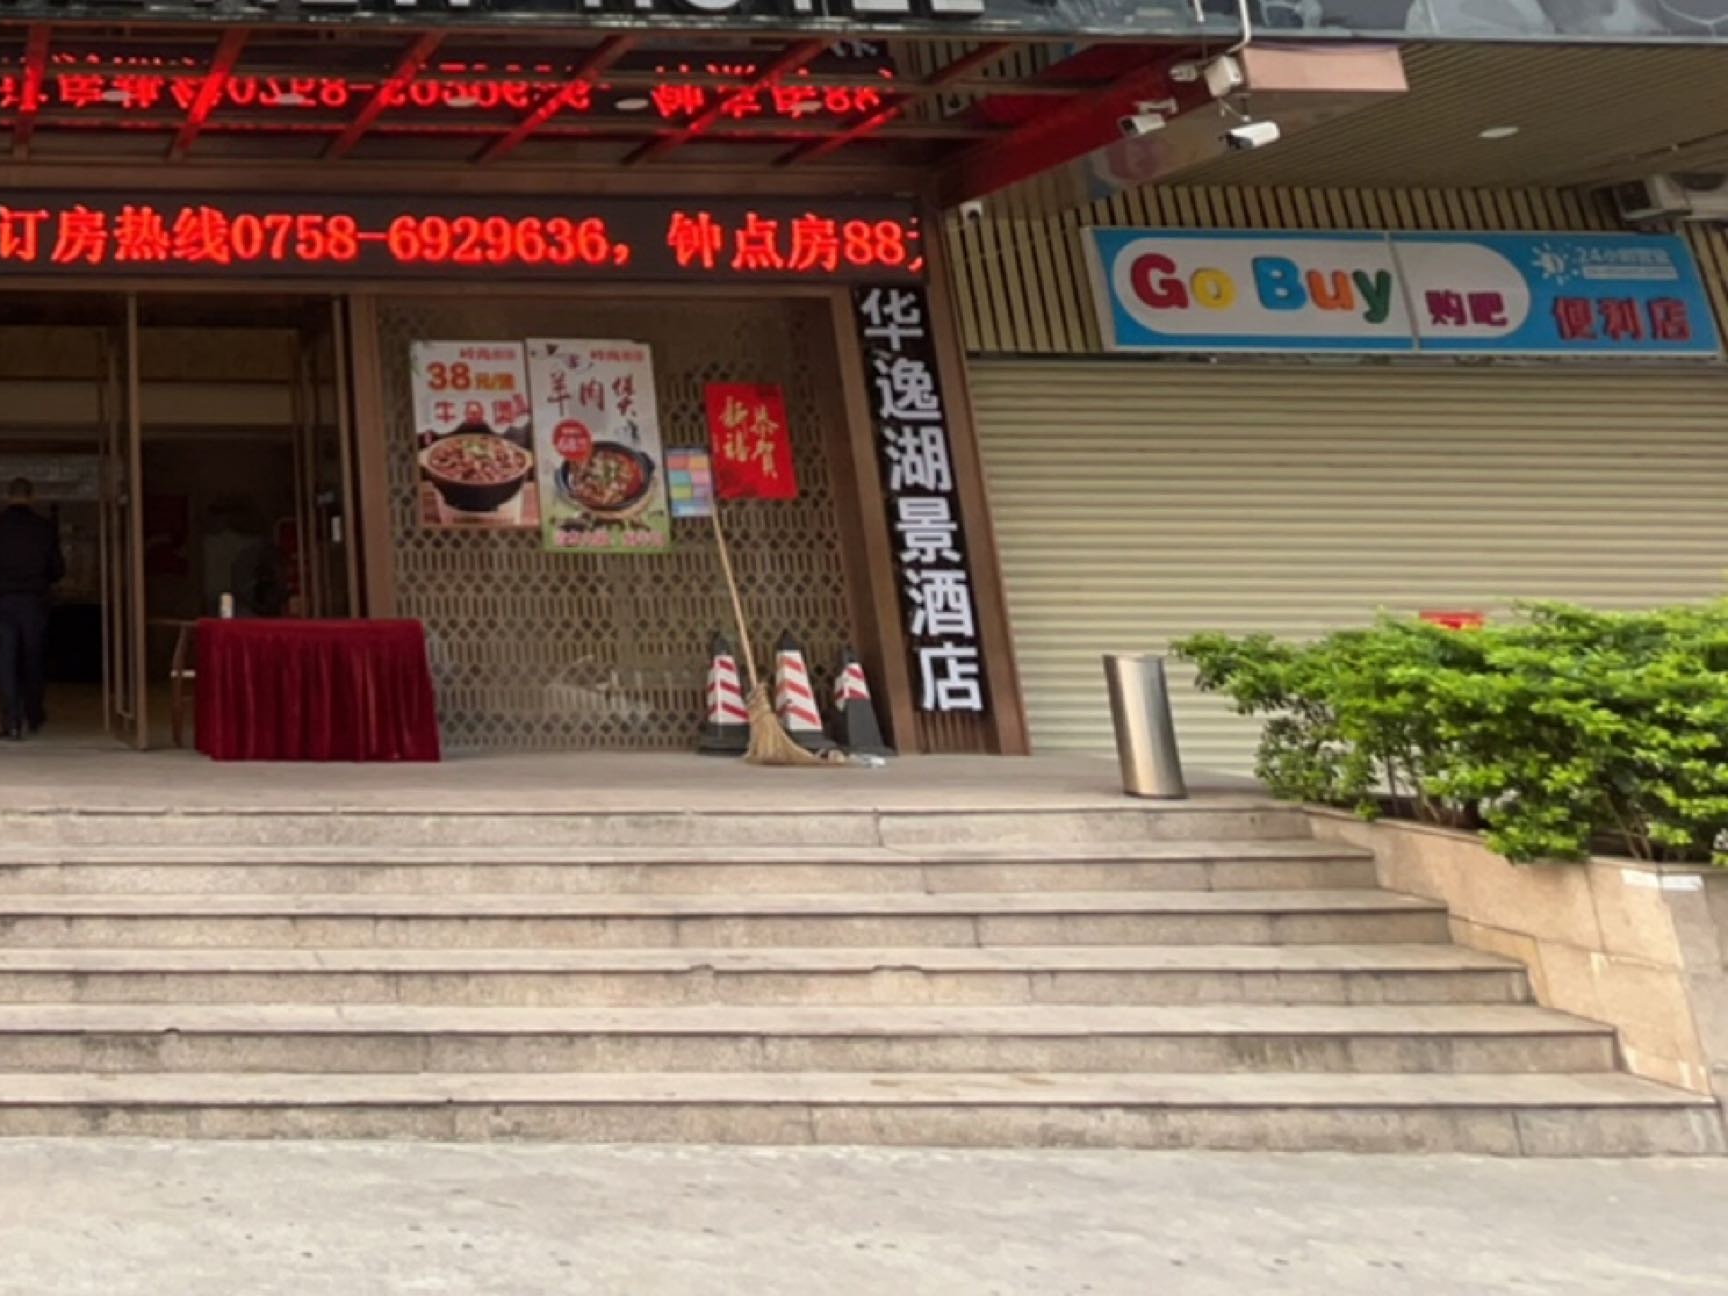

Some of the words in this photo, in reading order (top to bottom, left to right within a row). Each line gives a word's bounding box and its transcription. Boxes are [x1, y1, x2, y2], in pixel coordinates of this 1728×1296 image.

[1129, 252, 1236, 311] Go
[1251, 256, 1392, 324] Buy
[860, 287, 984, 713] 华逸湖景酒店
